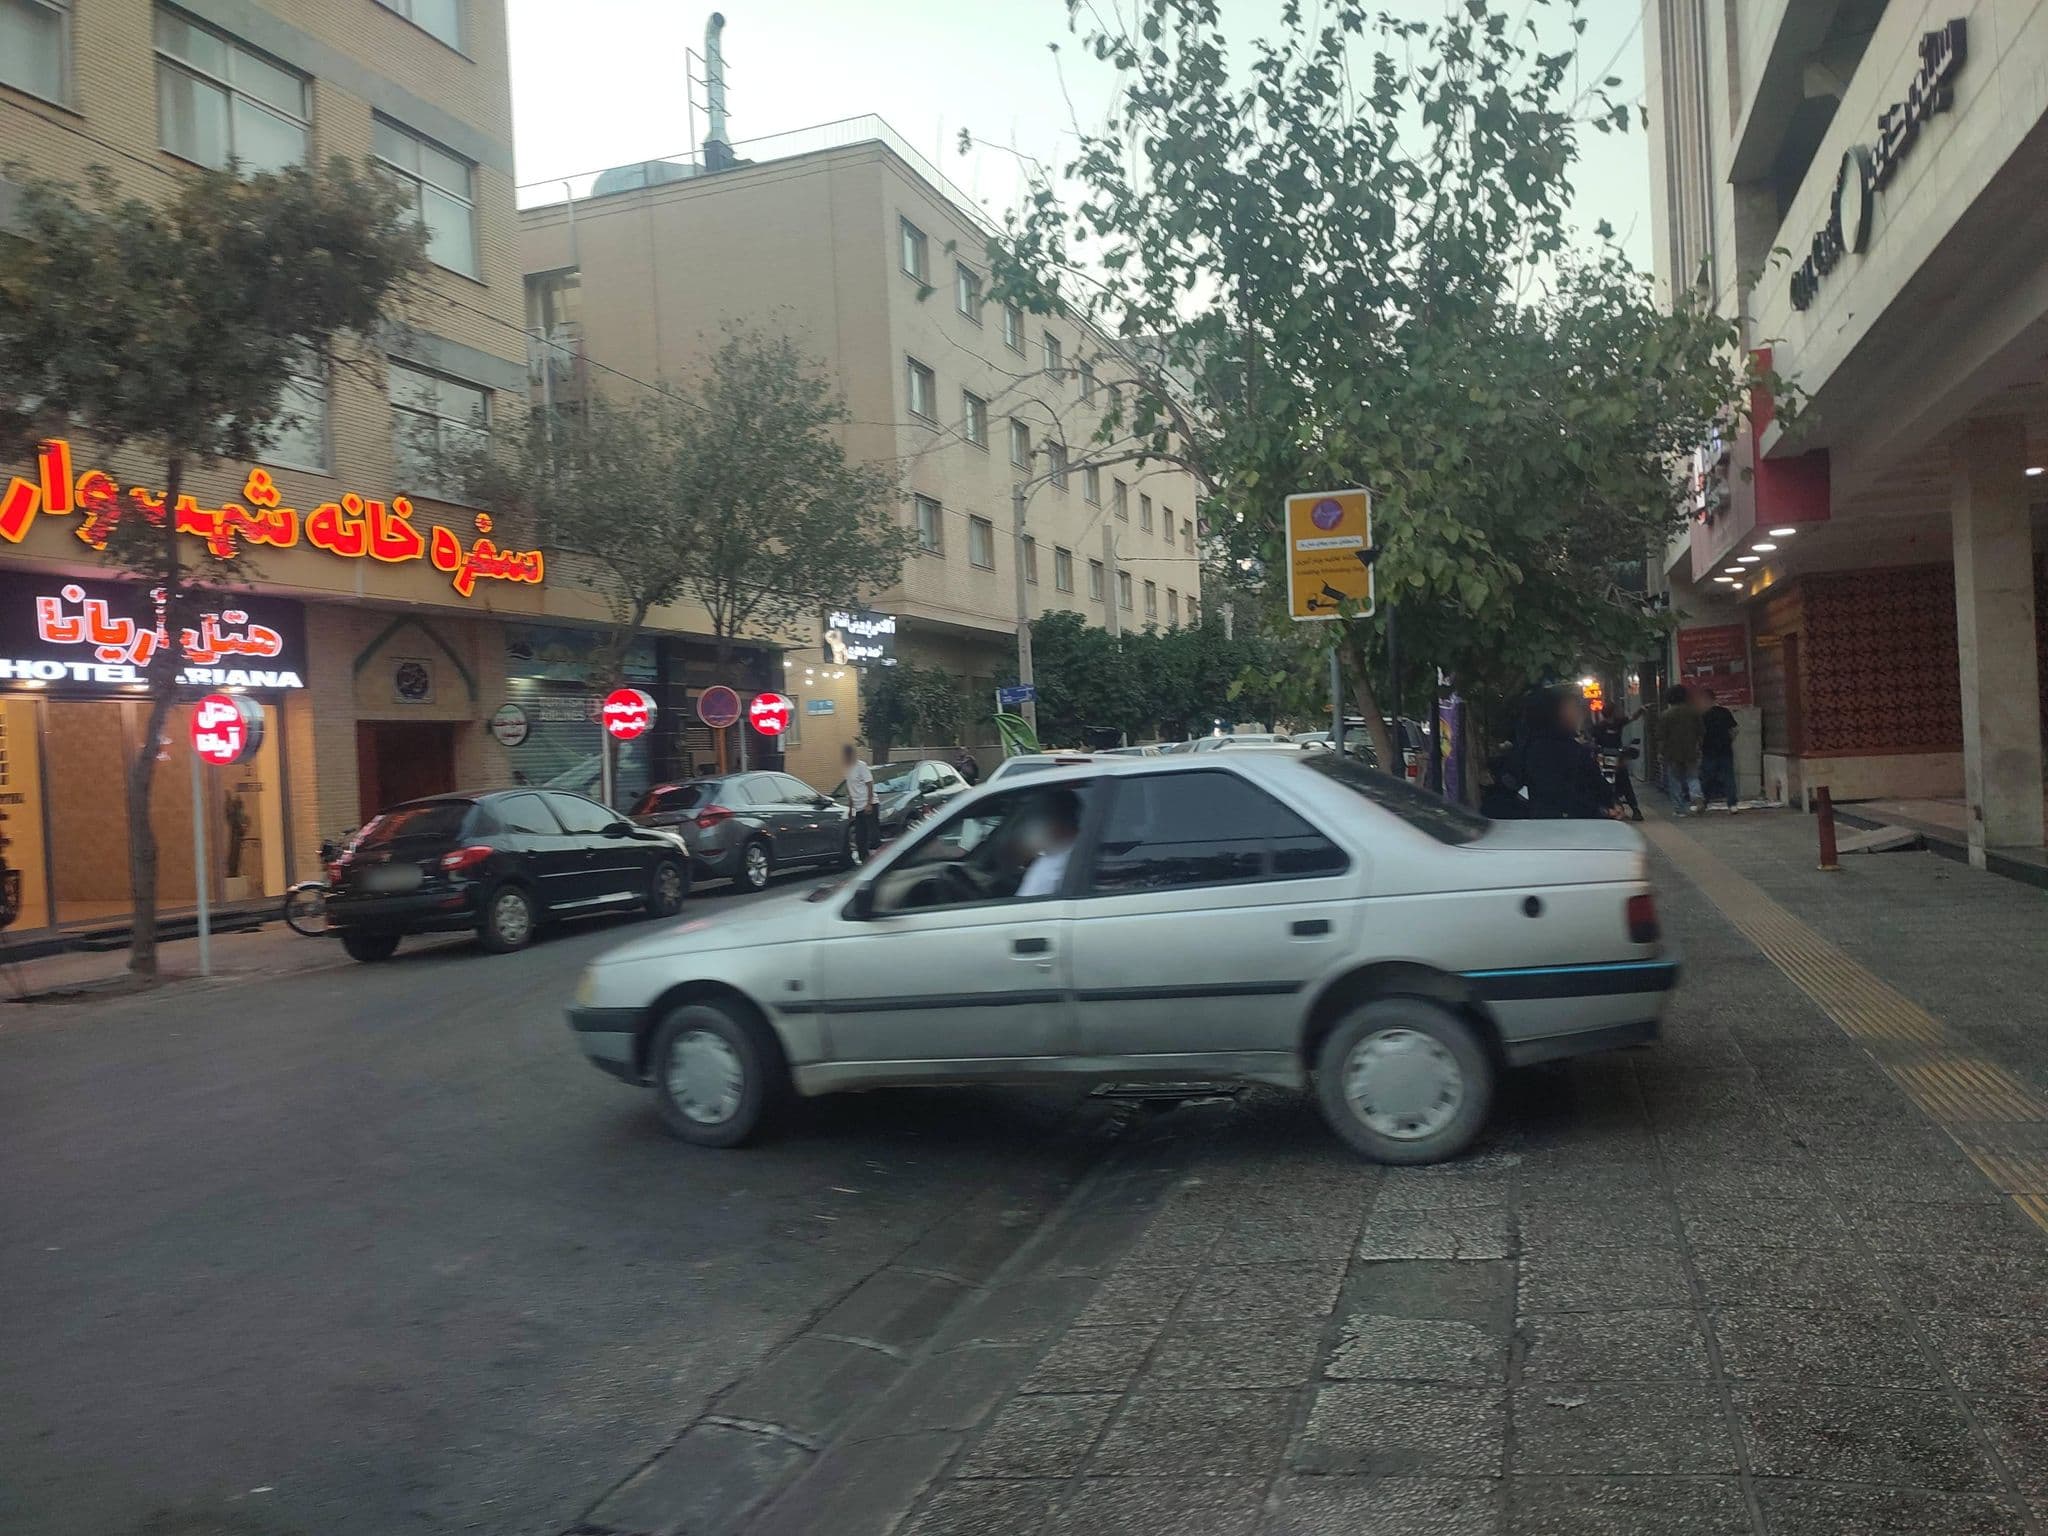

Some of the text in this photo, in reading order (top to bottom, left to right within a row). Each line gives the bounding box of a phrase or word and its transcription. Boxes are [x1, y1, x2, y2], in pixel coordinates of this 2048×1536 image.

[305, 493, 424, 562] خانه
[431, 512, 543, 598] سفره
[181, 610, 283, 664] هتل
[0, 659, 148, 683] HOTEL
